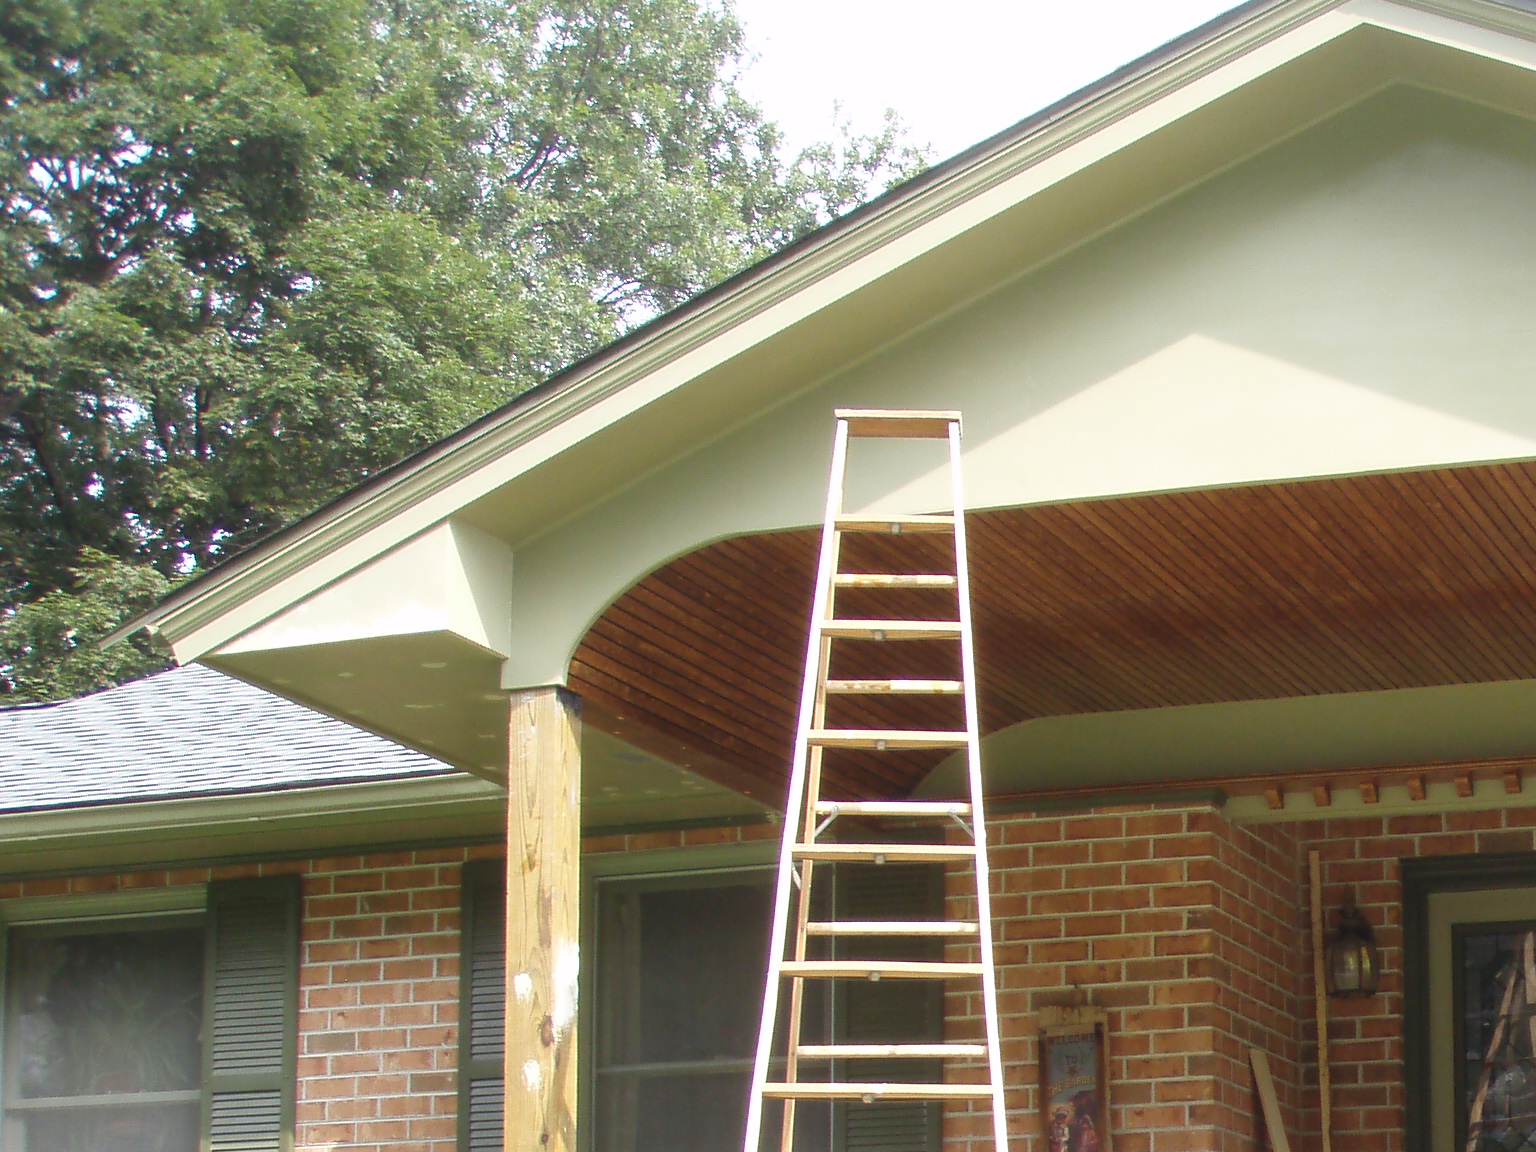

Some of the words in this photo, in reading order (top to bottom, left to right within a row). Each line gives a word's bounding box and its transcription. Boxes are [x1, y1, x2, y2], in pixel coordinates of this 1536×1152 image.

[1047, 1033, 1095, 1045] WELCOME
[1065, 1055, 1078, 1065] TO
[1048, 1082, 1062, 1096] THE
